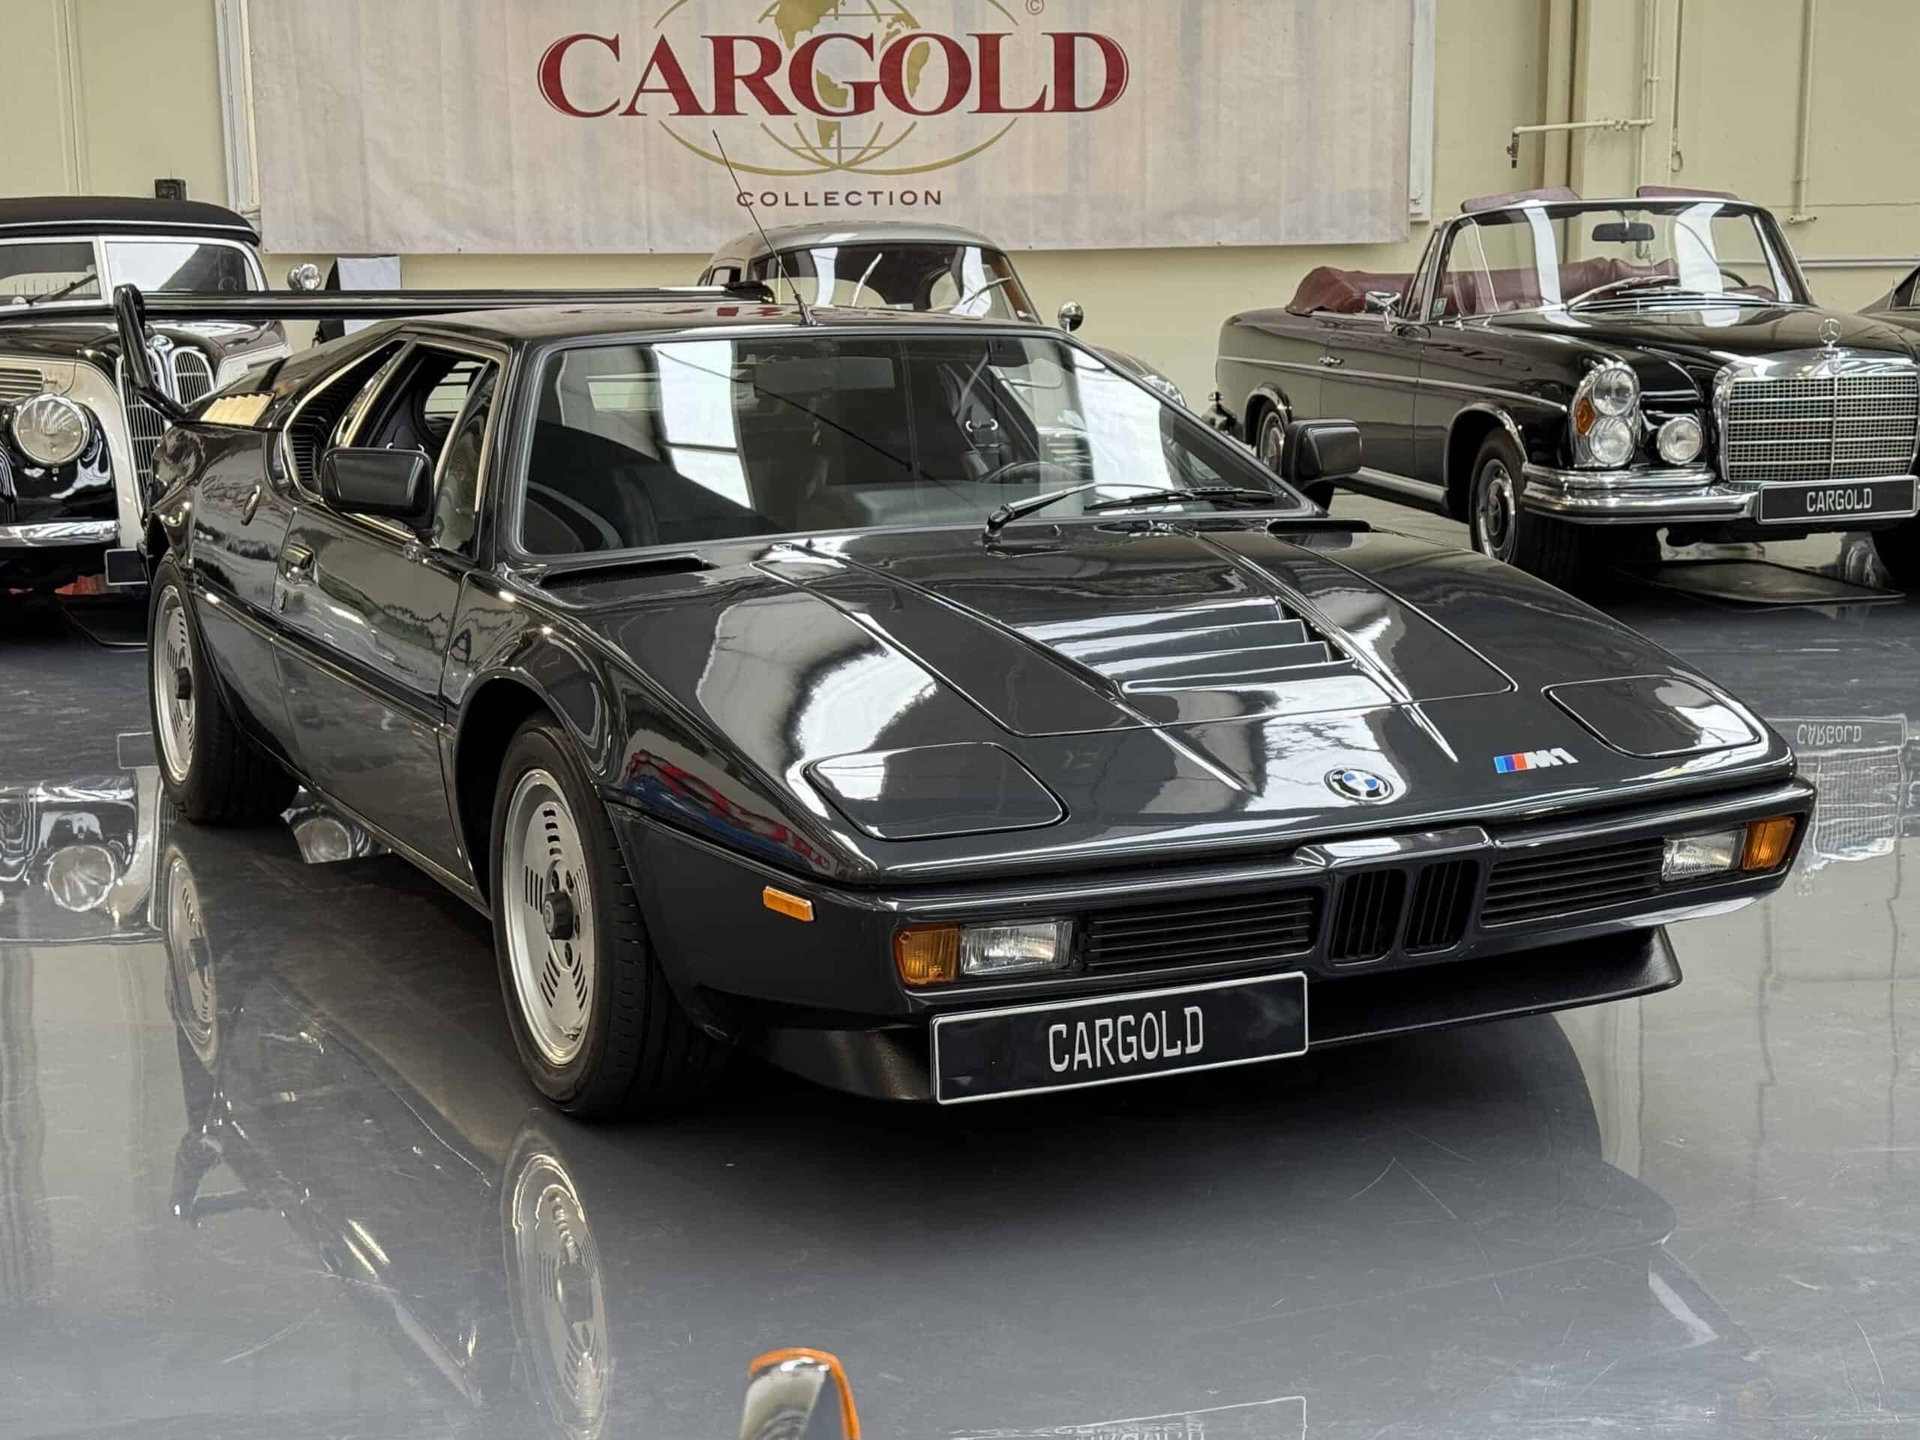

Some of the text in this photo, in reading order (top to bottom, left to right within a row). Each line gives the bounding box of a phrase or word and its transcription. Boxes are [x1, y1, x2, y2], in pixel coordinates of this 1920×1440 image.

[537, 33, 1130, 118] CARGOLD
[737, 190, 941, 207] COLLECTION
[1807, 488, 1872, 512] CARGOLD
[1524, 747, 1580, 768] M1
[1049, 1006, 1204, 1072] CARGOLD
